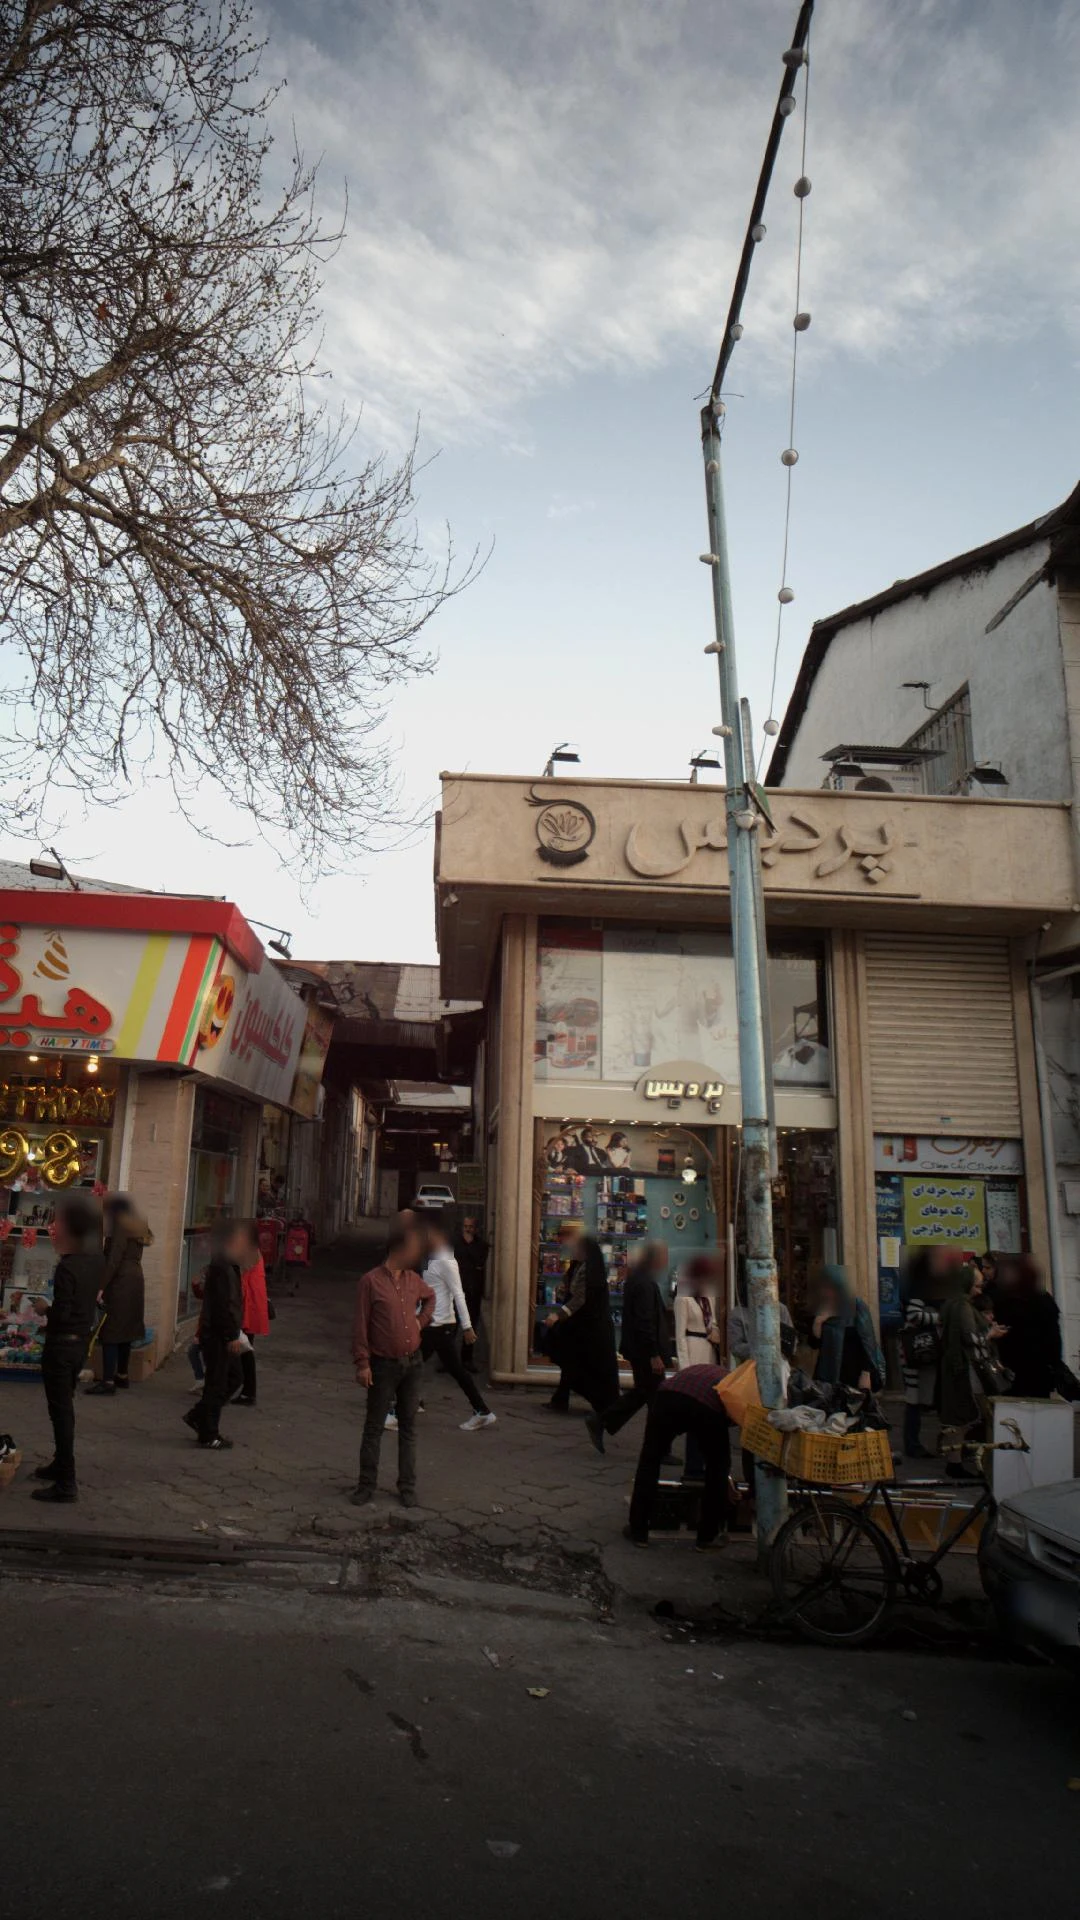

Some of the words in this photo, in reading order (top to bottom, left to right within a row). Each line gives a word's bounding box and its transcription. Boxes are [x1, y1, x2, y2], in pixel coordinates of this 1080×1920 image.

[40, 1037, 78, 1048] HAPPY
[81, 1039, 109, 1050] TIME
[644, 1080, 725, 1115] پردیس
[950, 1185, 976, 1200] ترکیب
[921, 1203, 949, 1217] موهای
[950, 1205, 969, 1218] رنگ
[912, 1224, 944, 1237] خارجی
[953, 1225, 979, 1238] ایرانی
